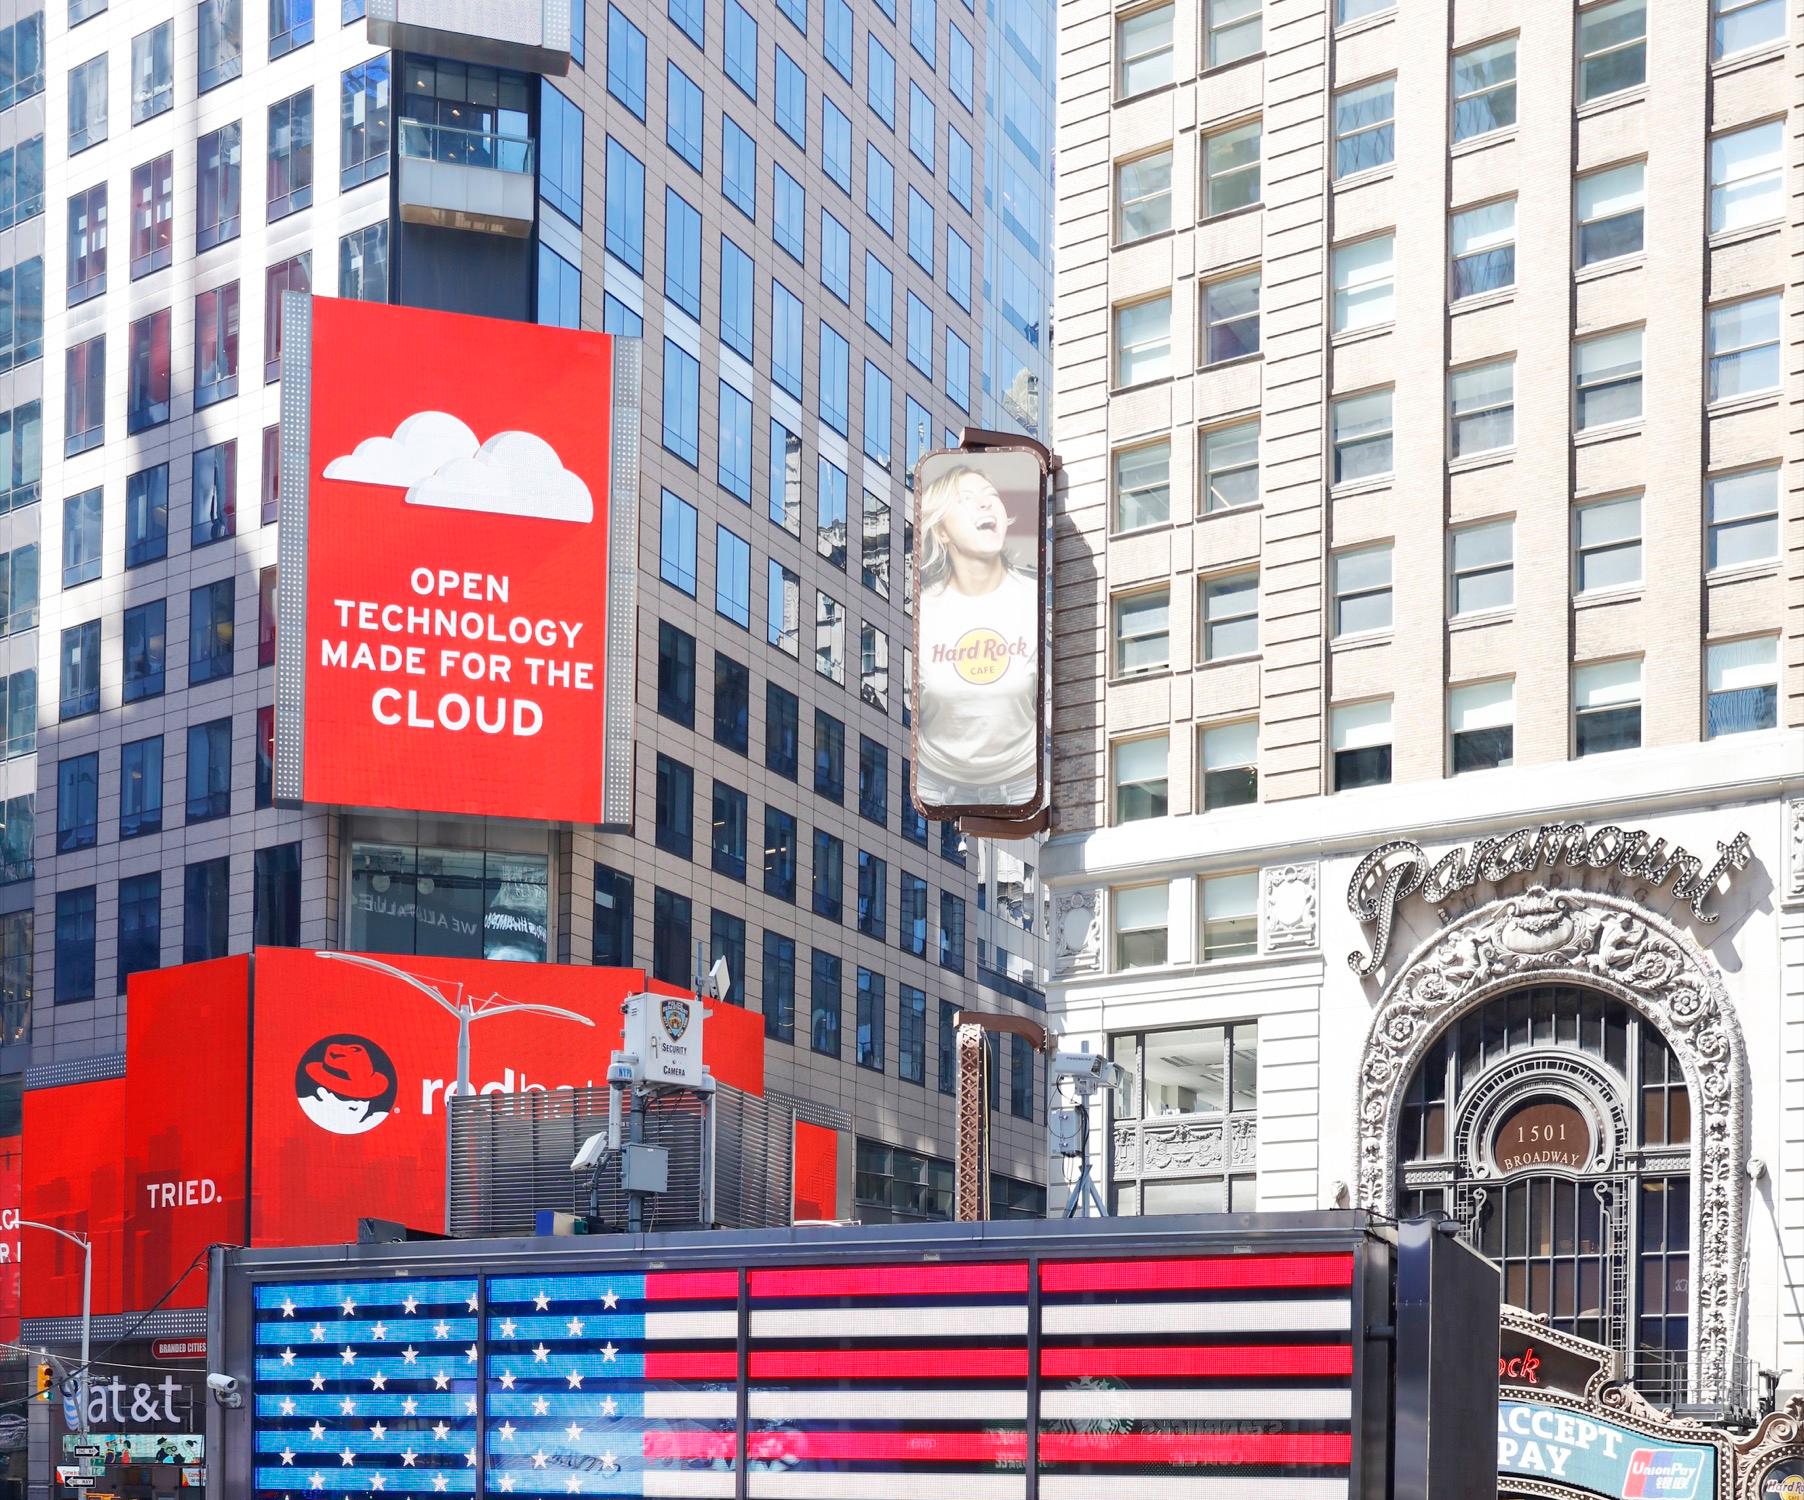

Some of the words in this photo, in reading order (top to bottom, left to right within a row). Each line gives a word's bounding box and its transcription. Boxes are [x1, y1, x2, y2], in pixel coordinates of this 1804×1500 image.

[410, 567, 509, 603] OPEN
[333, 599, 584, 648] TECHNOLOGY
[932, 639, 980, 662] Hard
[984, 636, 1029, 662] Rock
[321, 639, 426, 675] MADE
[440, 649, 511, 683] FOR
[524, 657, 594, 690] THE
[970, 666, 995, 675] CAFE
[371, 687, 544, 736] CLOUD
[1346, 822, 1752, 977] Paramount
[662, 1043, 687, 1055] SECURITY
[663, 1065, 686, 1076] CAMERA
[1518, 1123, 1566, 1143] 1501
[1503, 1150, 1581, 1170] BROADWAY
[146, 1178, 223, 1209] TRIED.
[159, 1343, 186, 1354] BRANDED
[187, 1342, 207, 1352] CITIES
[87, 1375, 182, 1423] at&t
[1498, 1436, 1572, 1476] PAY
[1631, 1461, 1696, 1482] UnionPay
[1765, 1479, 1795, 1493] Hard
